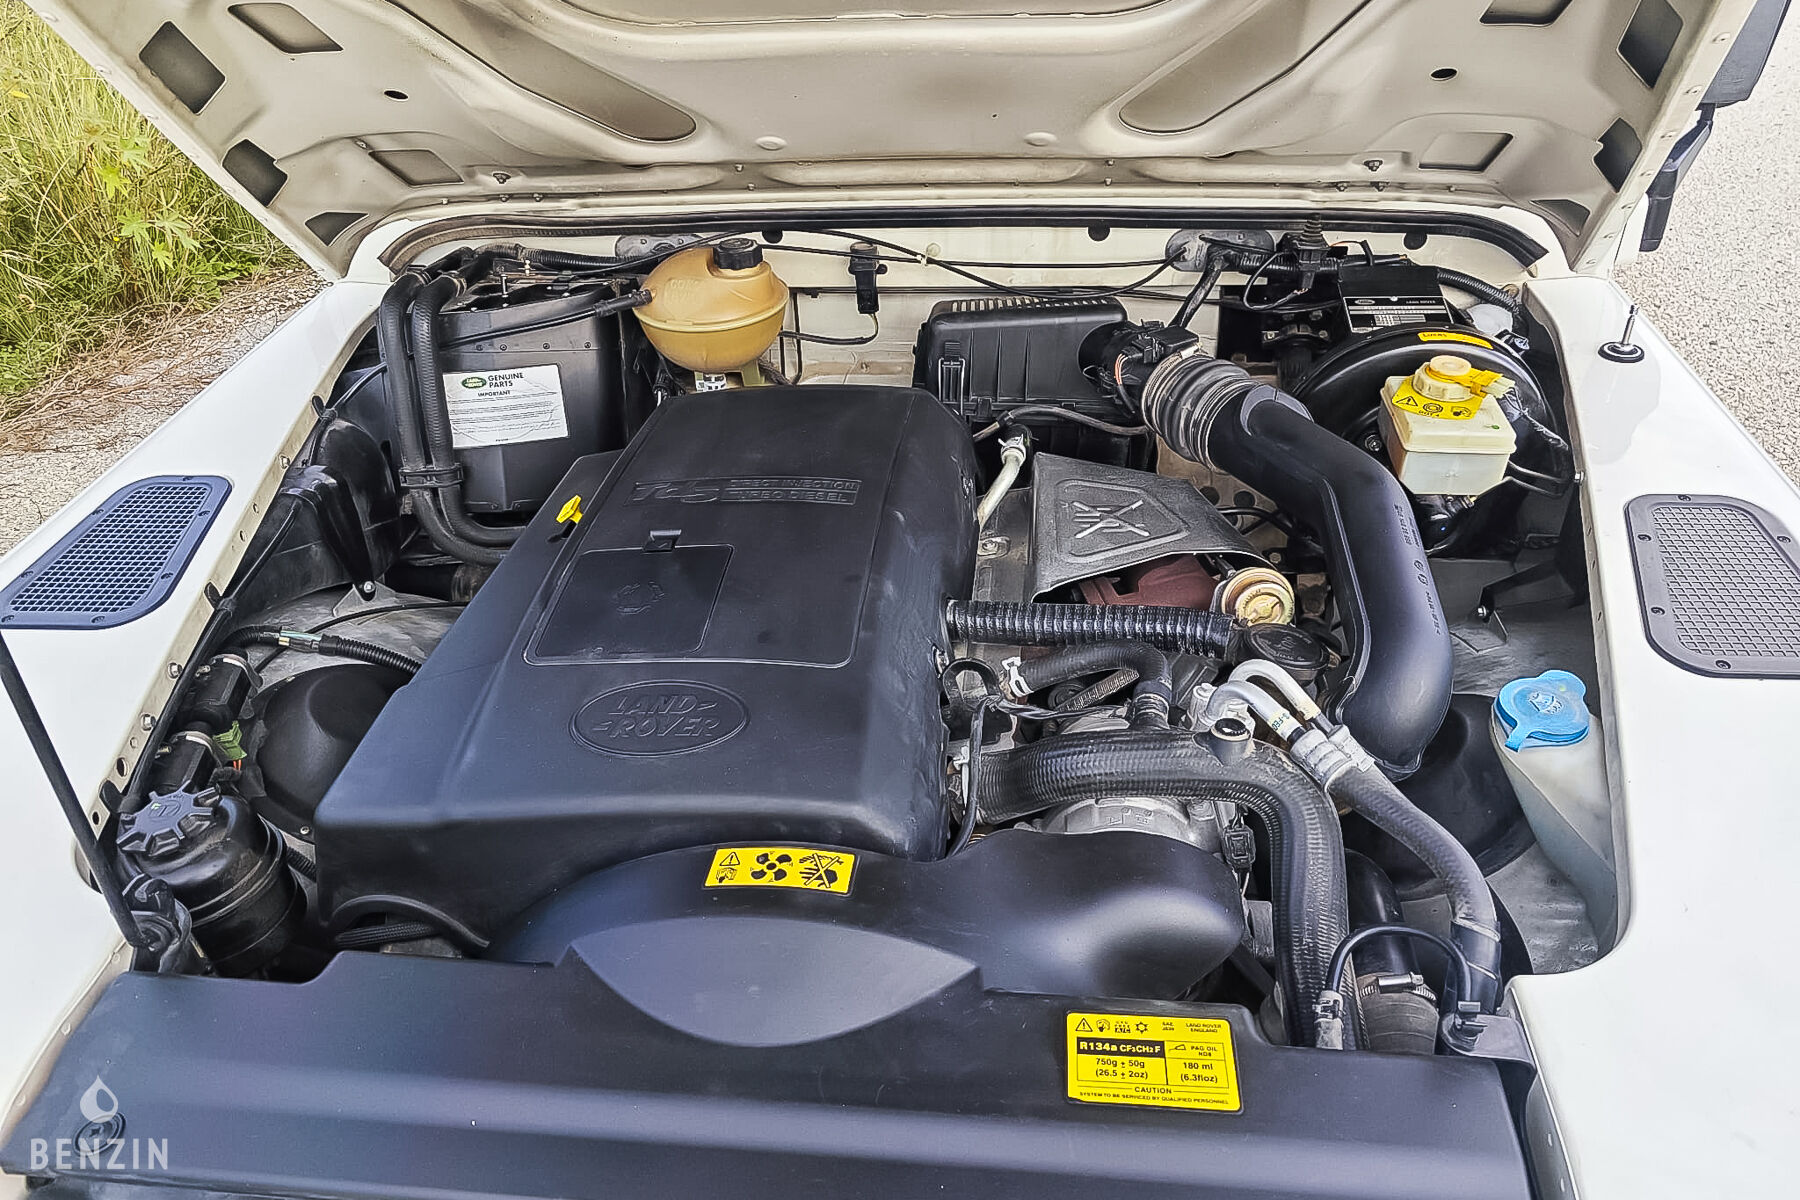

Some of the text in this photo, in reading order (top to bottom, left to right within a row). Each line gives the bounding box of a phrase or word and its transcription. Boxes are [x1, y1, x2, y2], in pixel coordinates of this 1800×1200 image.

[488, 372, 525, 381] GENUINE
[489, 380, 513, 388] PARTS
[790, 490, 849, 502] DIESEL
[609, 695, 698, 715] LAND
[609, 716, 720, 738] ROVER
[1079, 1041, 1118, 1052] R134a
[1096, 1058, 1118, 1068] 750g
[1128, 1060, 1145, 1069] 50g
[1183, 1062, 1214, 1071] 180 ml
[1095, 1069, 1118, 1078] (26.5
[1128, 1070, 1149, 1080] 2oz)
[1134, 1086, 1172, 1094] CAUTION
